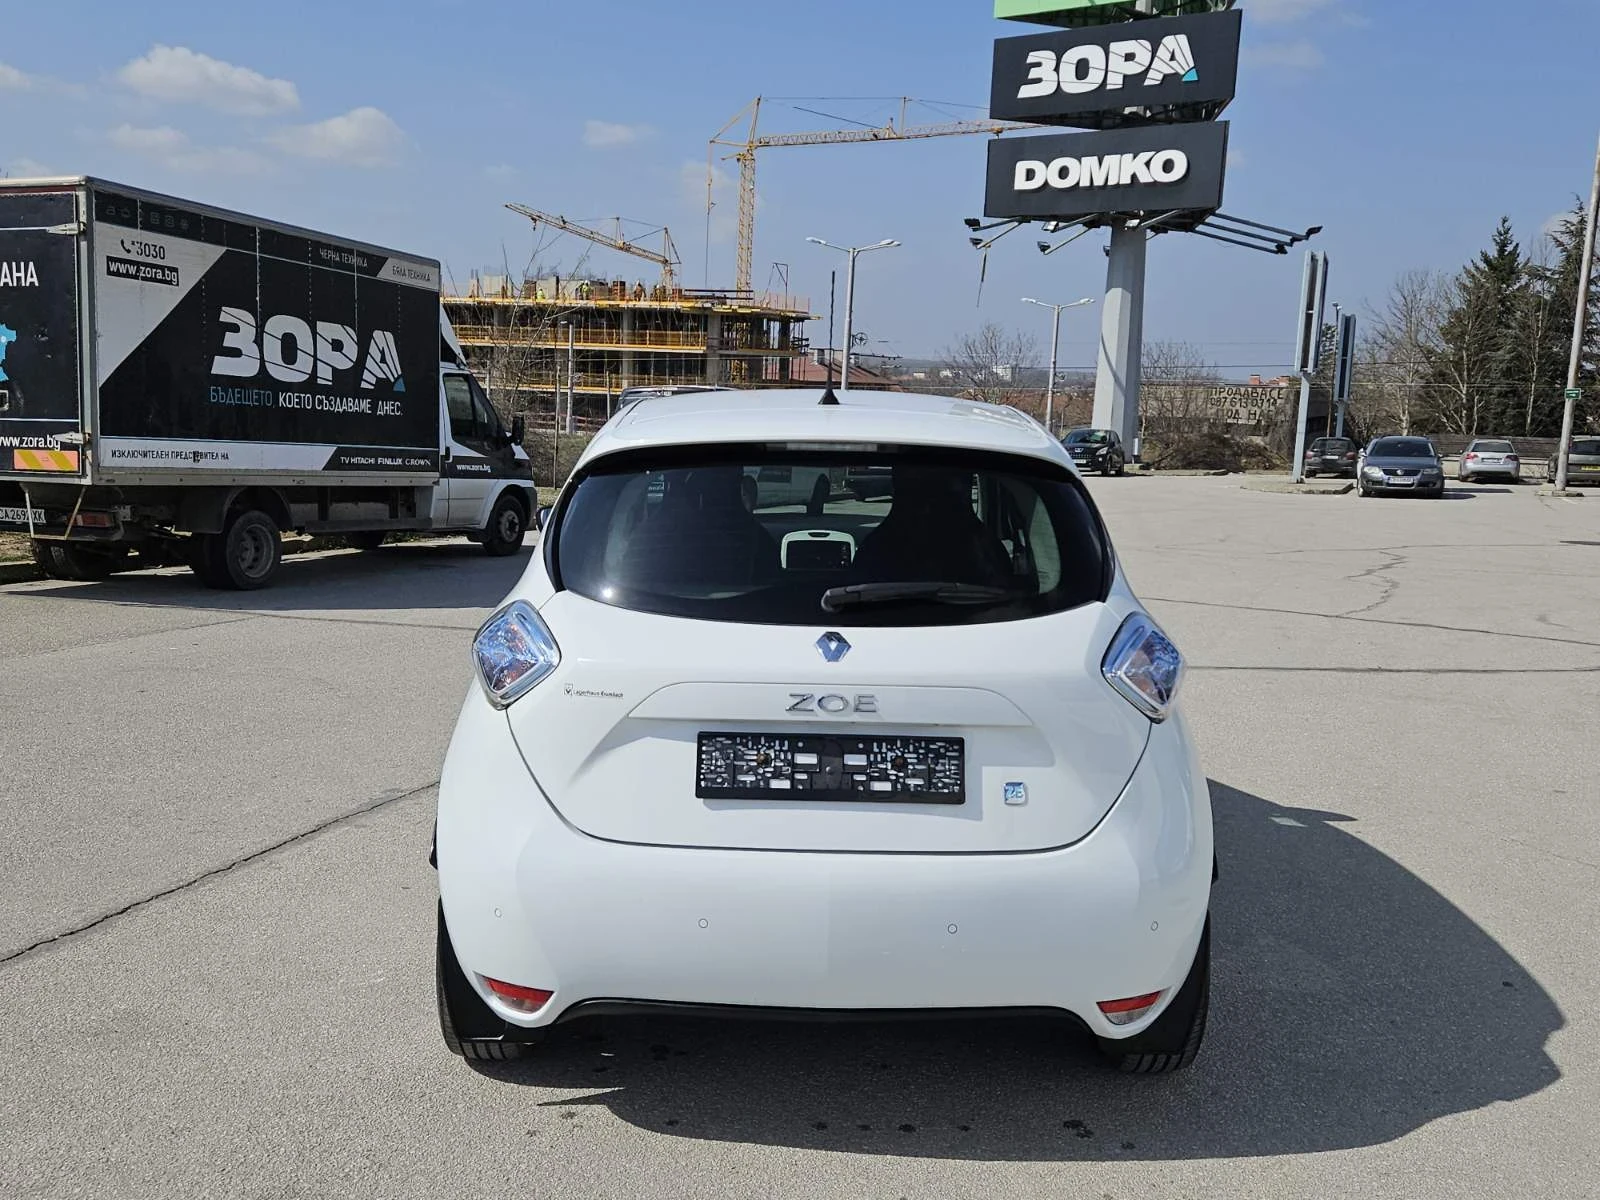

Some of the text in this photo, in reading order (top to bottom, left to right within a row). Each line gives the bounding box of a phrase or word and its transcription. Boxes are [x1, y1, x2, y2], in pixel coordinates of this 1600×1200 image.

[1016, 33, 1198, 98] ЗОРА
[1013, 149, 1188, 190] DOMKO
[108, 261, 178, 285] www.zora.bg
[210, 306, 406, 392] ЗОРА
[279, 391, 312, 409] КОЕТО
[315, 396, 372, 414] СЪЗДАВАМЕ
[0, 434, 61, 452] ww.zora.bg
[111, 449, 229, 461] ИЗКЛЮЧИТЕЛЕН ПРЕДСВИТЕЛ НА
[350, 457, 375, 465] HITACHI
[377, 457, 403, 465] FINLUX
[405, 458, 431, 466] CROWN
[456, 464, 491, 473] www.zora.bg
[785, 693, 877, 713] ZOE
